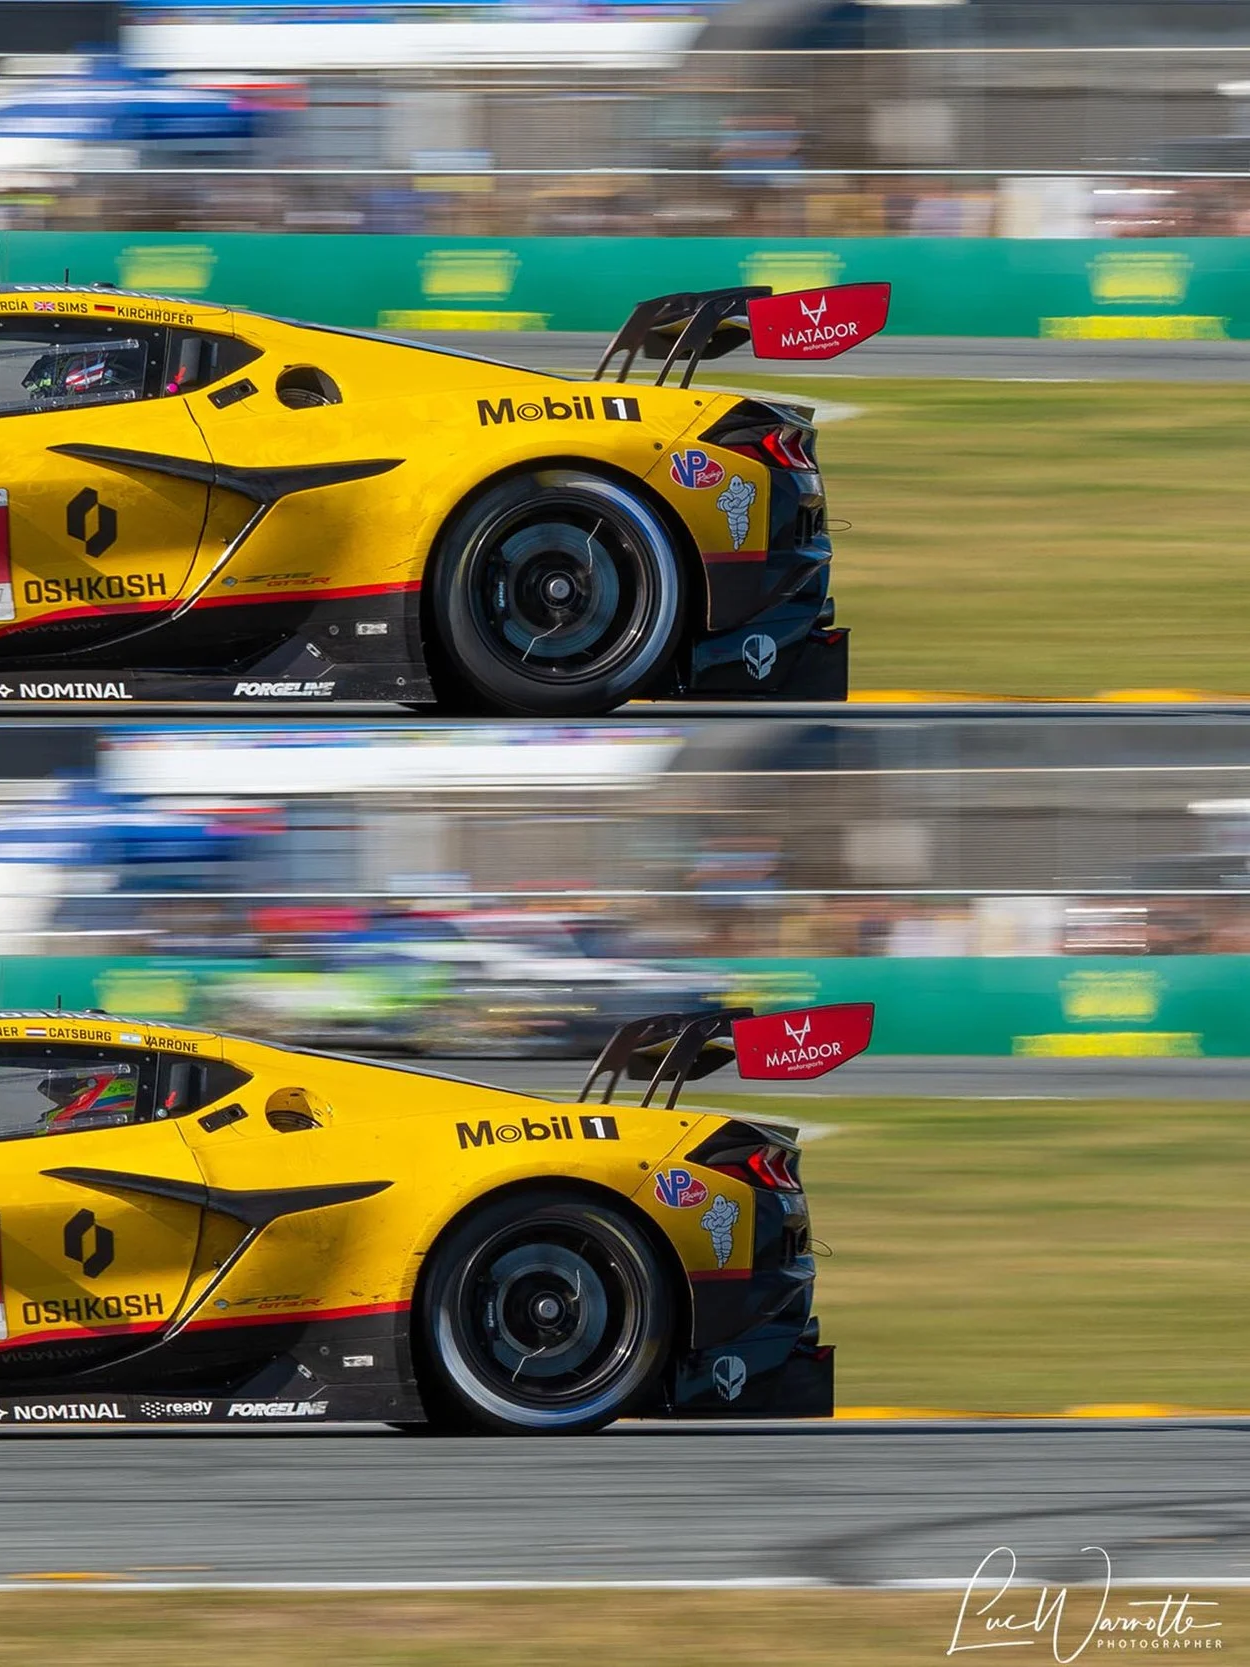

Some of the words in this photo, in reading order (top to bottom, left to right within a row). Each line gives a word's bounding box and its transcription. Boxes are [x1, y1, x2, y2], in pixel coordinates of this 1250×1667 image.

[57, 302, 88, 313] SIMS
[781, 322, 859, 347] MATADOR
[803, 340, 840, 352] motorsports
[477, 396, 595, 426] Mobil
[670, 449, 708, 489] VP
[24, 573, 167, 605] OSHKOSH
[19, 682, 133, 699] NOMINAL
[233, 682, 336, 696] FORGELINE
[48, 1027, 112, 1042] CATSBURG
[143, 1035, 199, 1053] VARRONE
[766, 1042, 842, 1067] MATADOR
[787, 1060, 824, 1072] motorsports
[456, 1116, 574, 1149] Mobil
[654, 1168, 693, 1207] VP
[23, 1293, 164, 1326] OSHKOSH
[13, 1403, 126, 1420] NOMINAL
[166, 1400, 213, 1415] ready
[227, 1401, 329, 1417] FORGELINE
